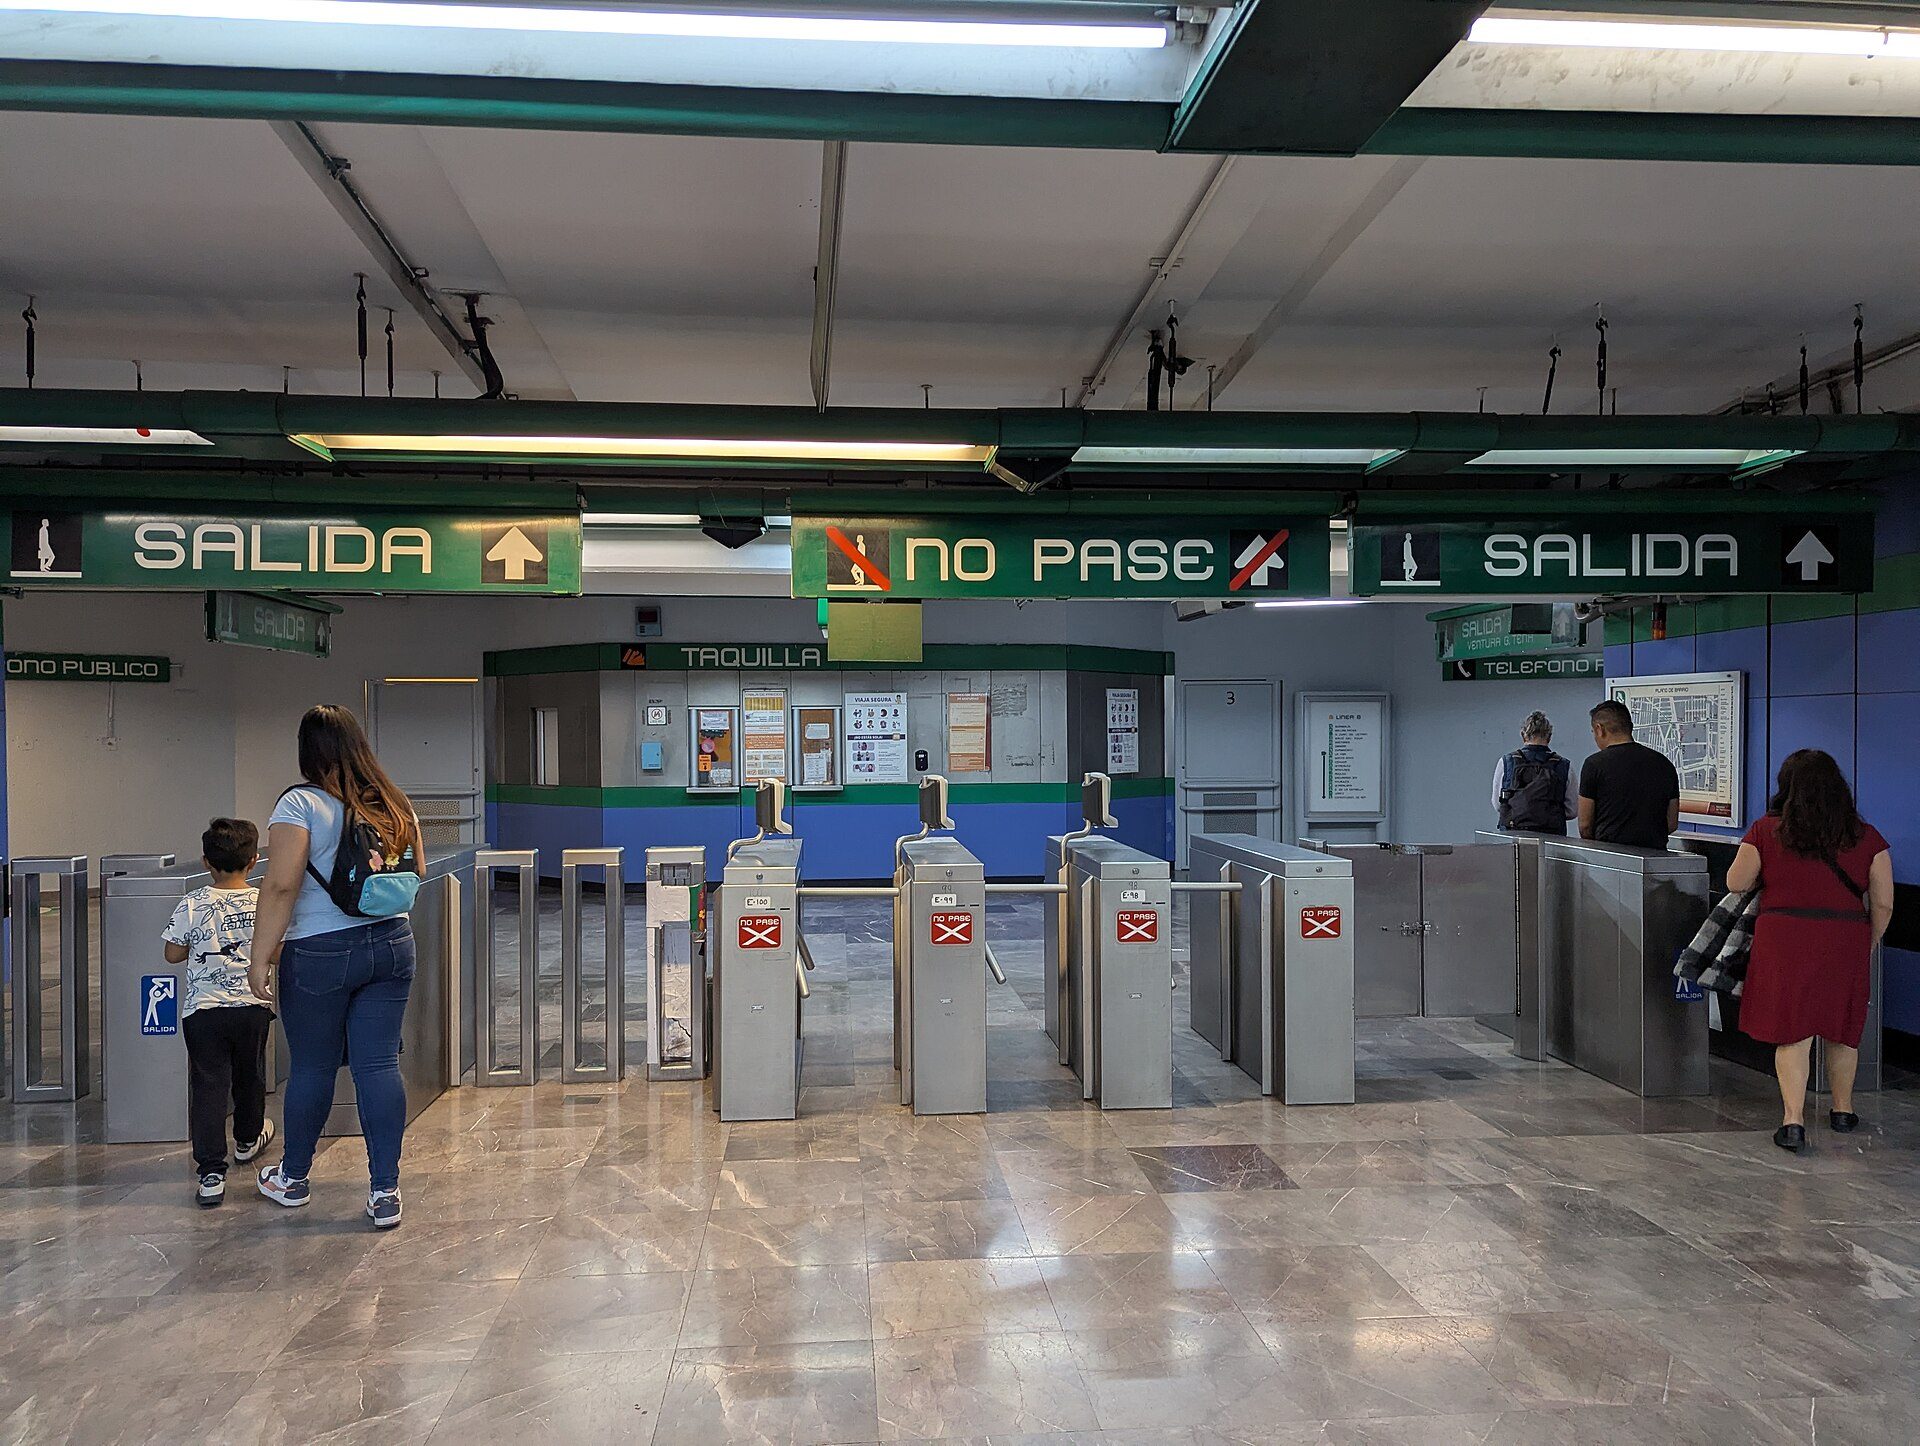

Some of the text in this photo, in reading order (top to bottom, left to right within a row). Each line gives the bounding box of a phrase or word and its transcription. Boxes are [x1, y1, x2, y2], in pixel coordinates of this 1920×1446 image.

[134, 523, 432, 574] SALIDA
[1484, 533, 1738, 577] SALIDA
[906, 537, 1214, 582] NO PASE
[254, 606, 305, 642] SALIDA
[1461, 616, 1502, 638] SALIDA
[1467, 637, 1501, 651] VENTURA
[681, 647, 821, 667] TAQUILLA
[1484, 659, 1590, 675] TELEFONO
[62, 660, 158, 677] PUBLICO
[1226, 691, 1235, 705] 3
[755, 918, 780, 926] PASE
